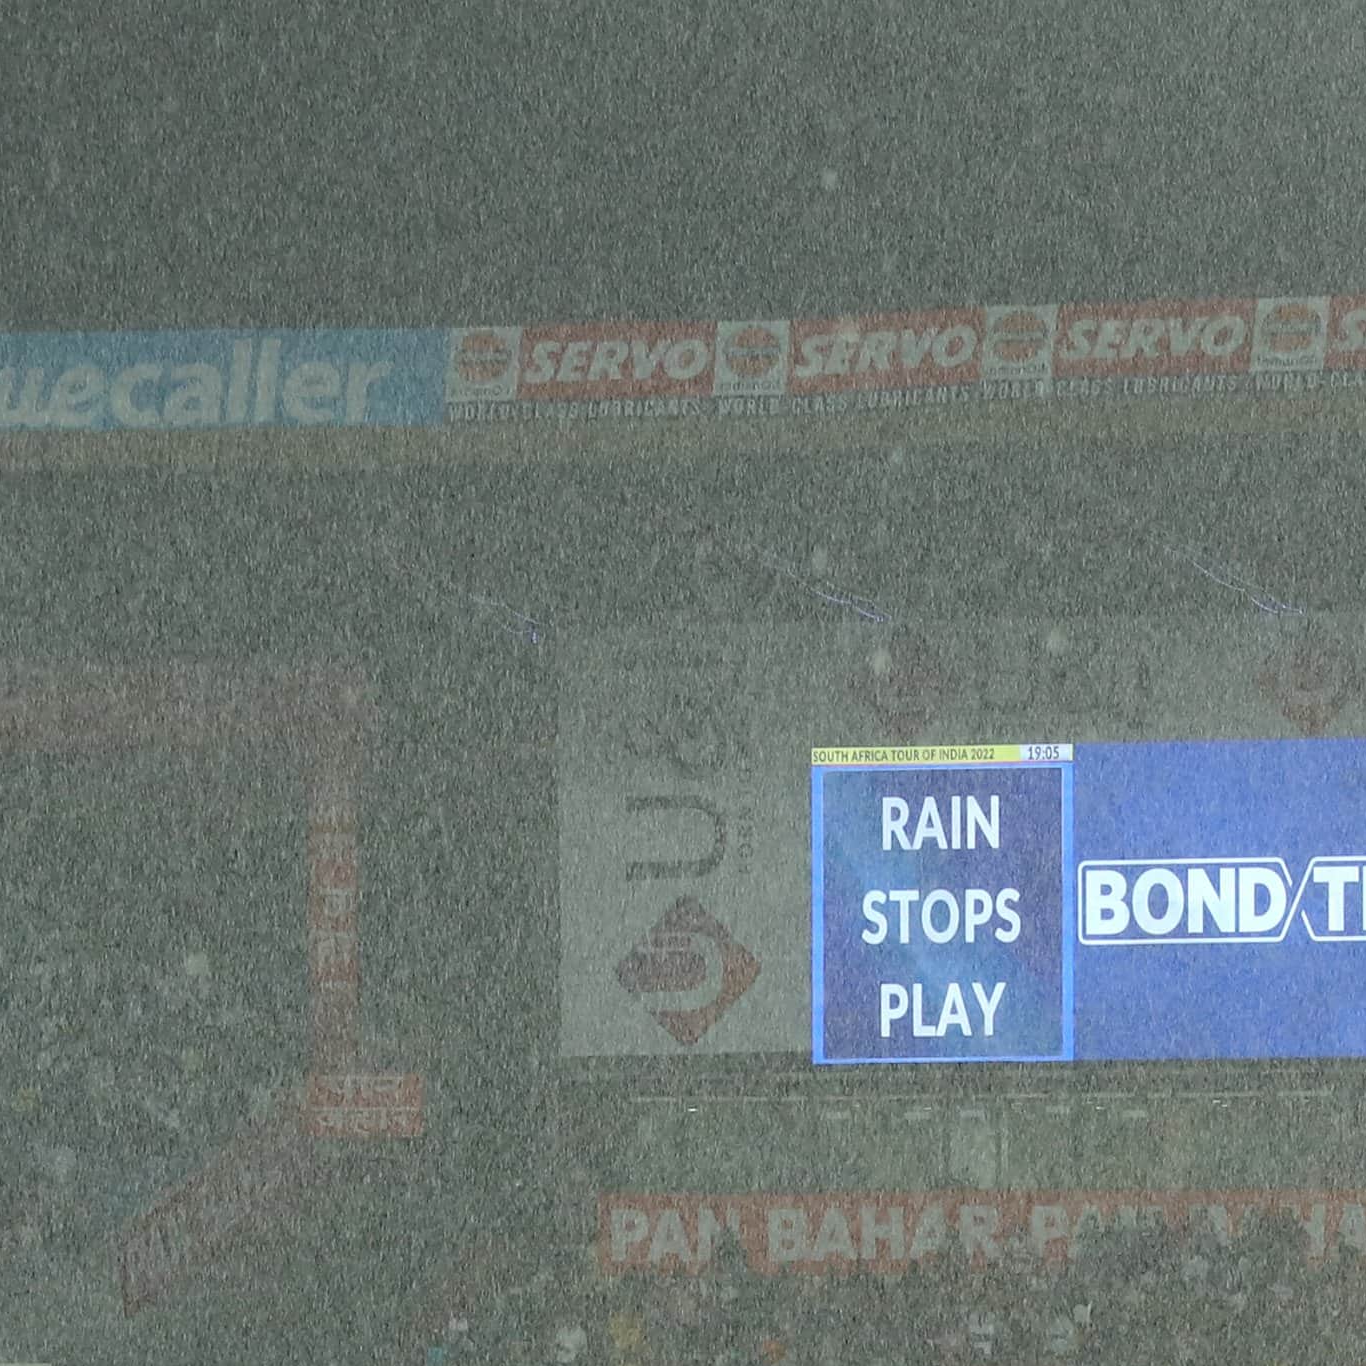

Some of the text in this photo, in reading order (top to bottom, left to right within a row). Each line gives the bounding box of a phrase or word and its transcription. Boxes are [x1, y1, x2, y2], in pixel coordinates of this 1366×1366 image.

[526, 340, 708, 384] SERVO
[796, 325, 976, 378] SERVO
[1064, 314, 1245, 362] SERVO
[813, 745, 1060, 763] SOUTH AFRICA TOUR OF INDIA 2022 19:05
[882, 794, 1000, 850] RAIN
[861, 887, 1022, 945] STOPS
[880, 981, 1007, 1038] PLAY
[610, 1206, 744, 1263] PAN
[766, 1203, 1003, 1262] BAHAR
